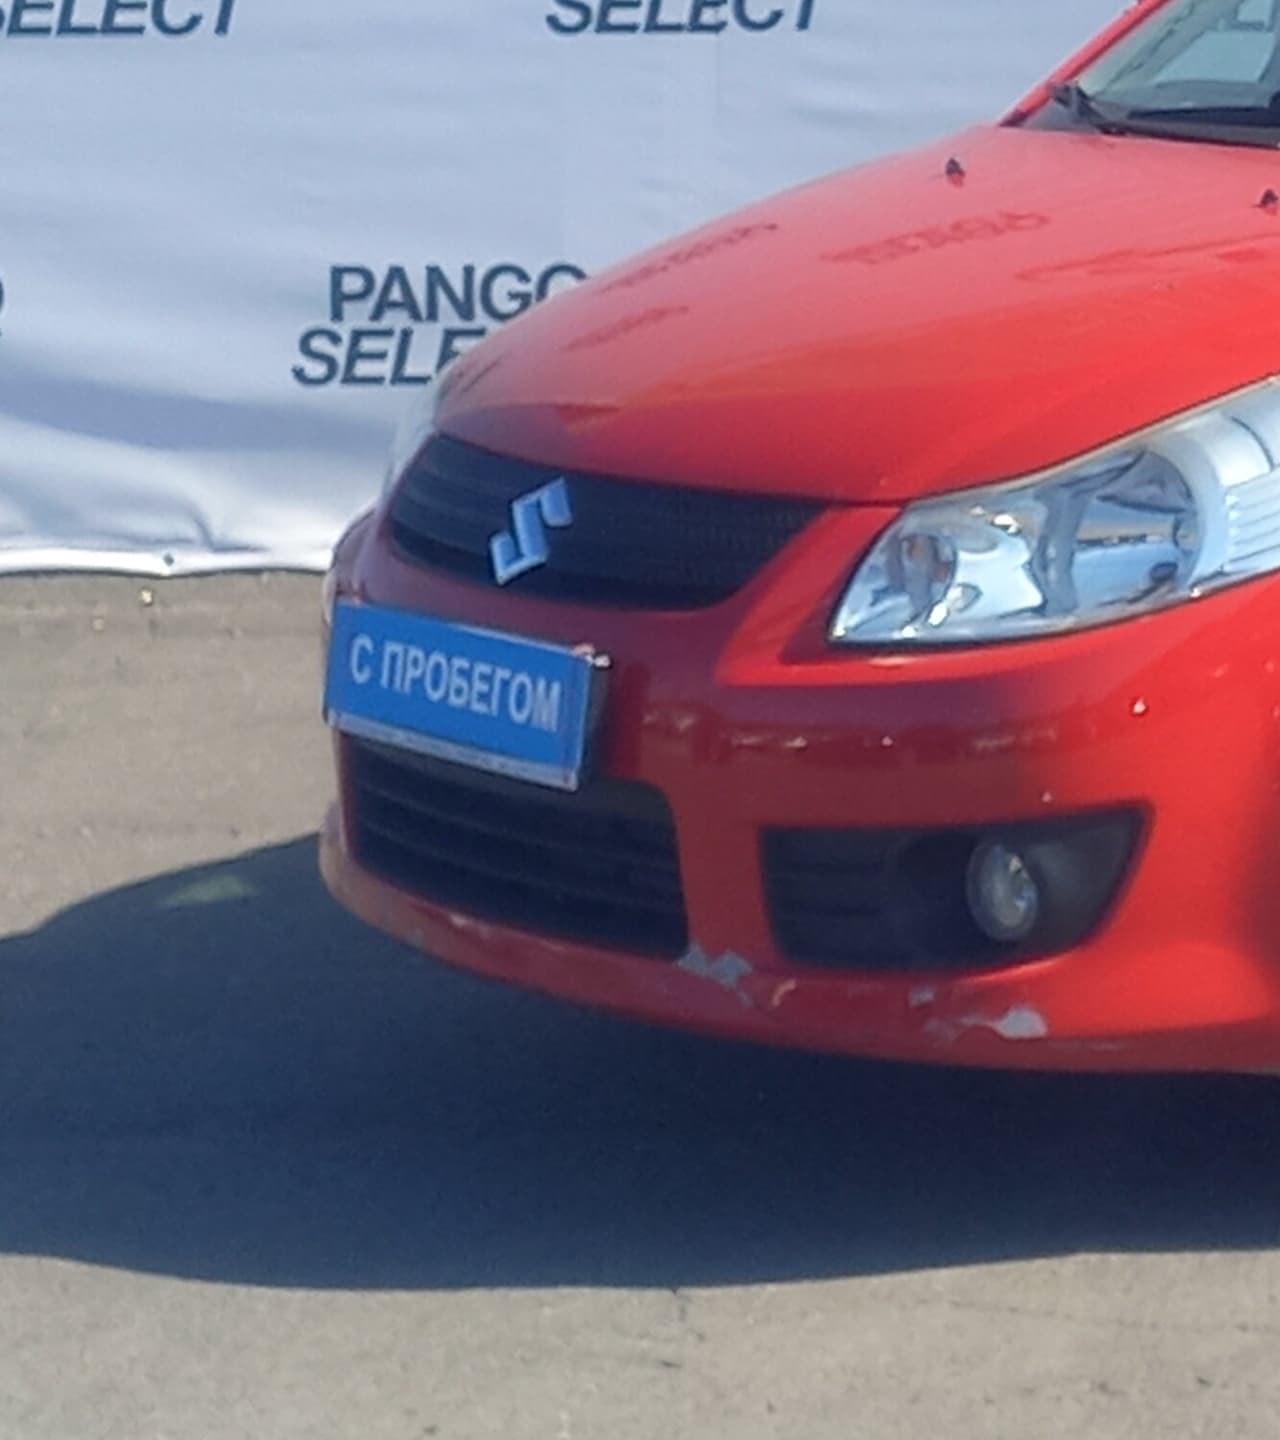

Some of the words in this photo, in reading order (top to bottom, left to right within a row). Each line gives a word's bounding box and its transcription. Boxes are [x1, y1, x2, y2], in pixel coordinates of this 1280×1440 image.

[291, 326, 487, 387] SELE
[350, 633, 374, 684] С
[381, 642, 561, 731] ПРОБЕГОМ
